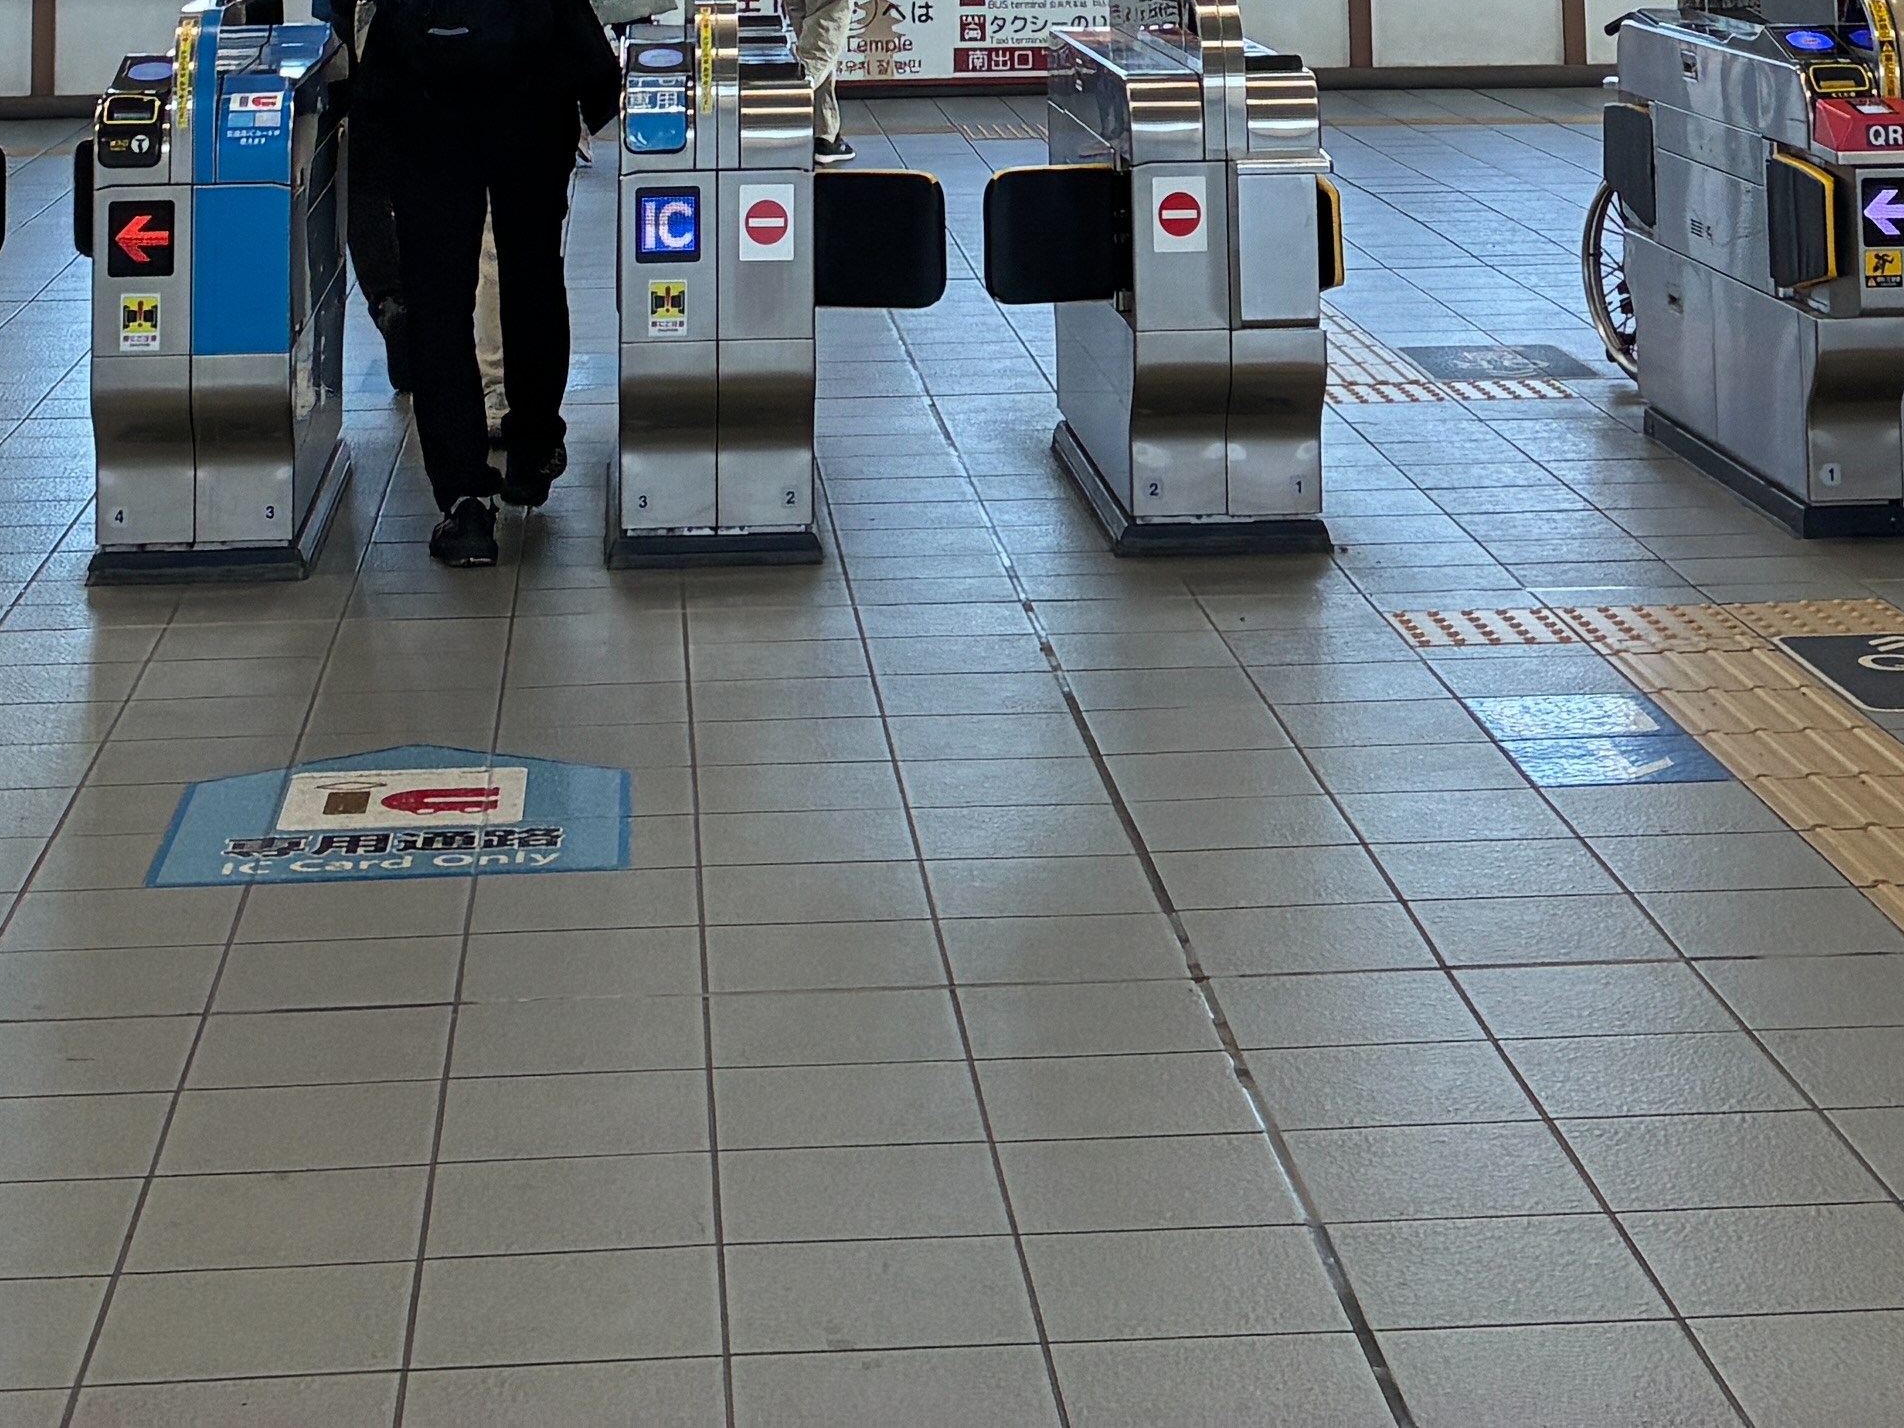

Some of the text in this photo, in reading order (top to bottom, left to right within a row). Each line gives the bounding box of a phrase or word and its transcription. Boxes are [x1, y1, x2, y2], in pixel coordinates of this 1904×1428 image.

[968, 50, 1032, 70] 南出口
[1869, 126, 1904, 146] QR
[644, 201, 693, 251] IC
[1828, 467, 1835, 482] 1
[1149, 483, 1159, 496] 2
[1296, 480, 1302, 494] 1
[638, 495, 648, 508] 3
[786, 491, 795, 504] 2
[114, 510, 124, 524] 4
[266, 506, 274, 519] 3
[222, 850, 561, 875] IC Card Only
